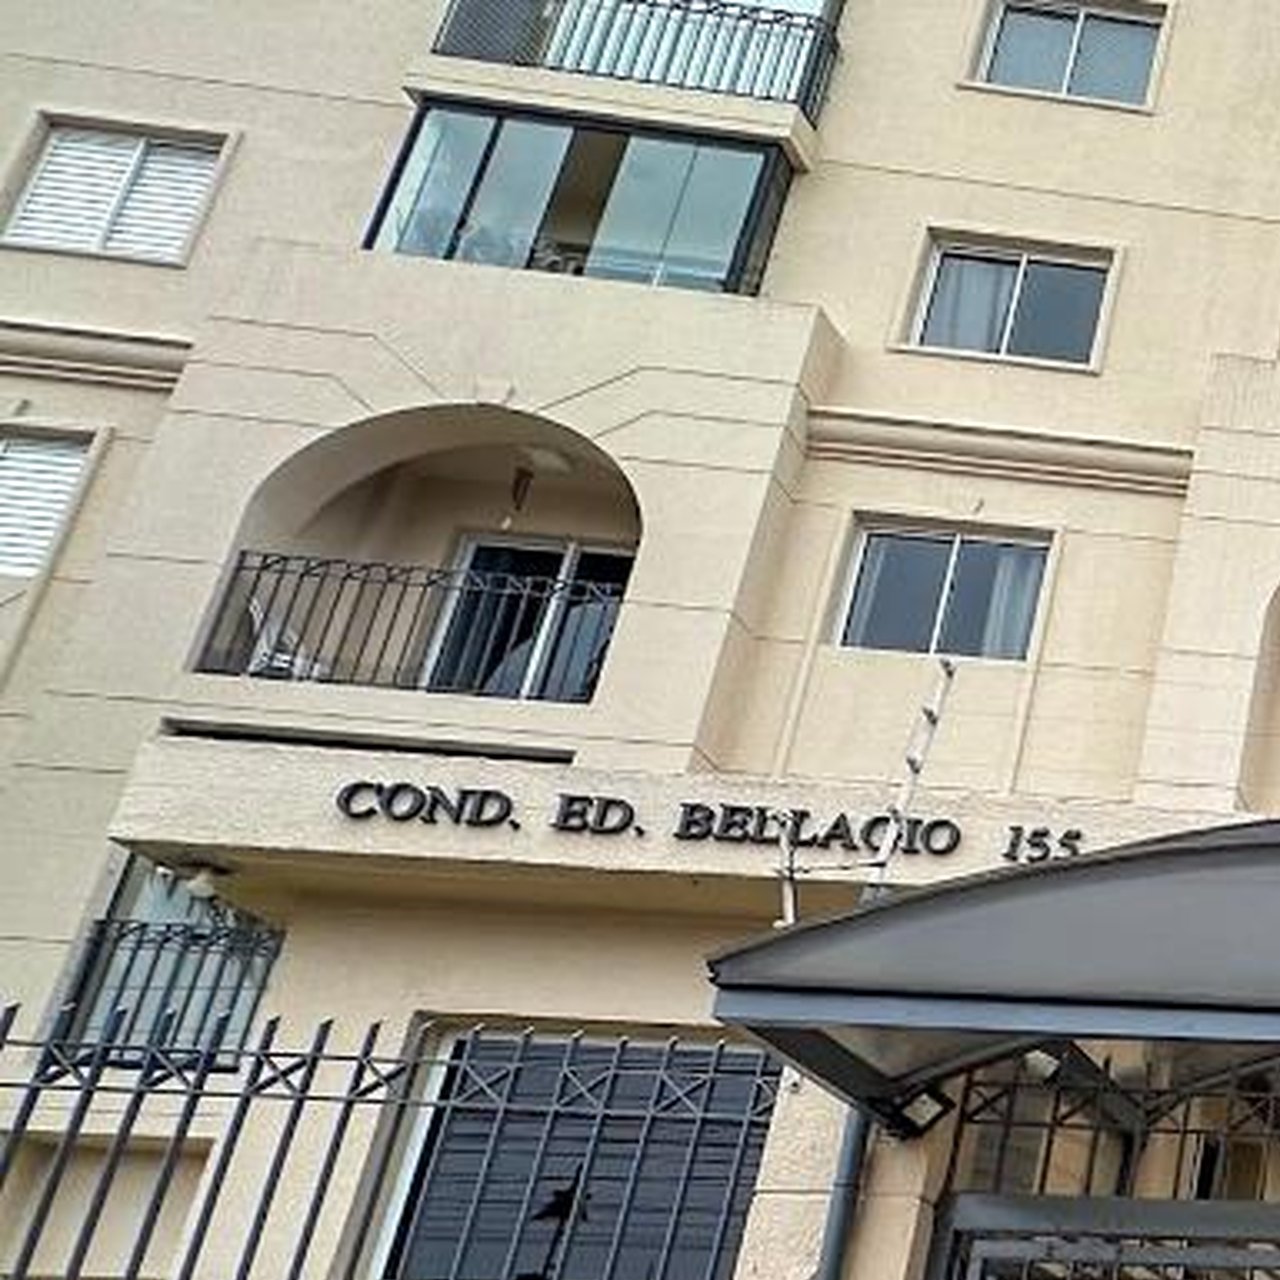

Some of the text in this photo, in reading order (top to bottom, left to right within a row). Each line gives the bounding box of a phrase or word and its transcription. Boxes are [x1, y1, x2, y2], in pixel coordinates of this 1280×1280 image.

[336, 781, 520, 830] COND.
[550, 794, 645, 837] ED.
[1002, 825, 1082, 864] 155
